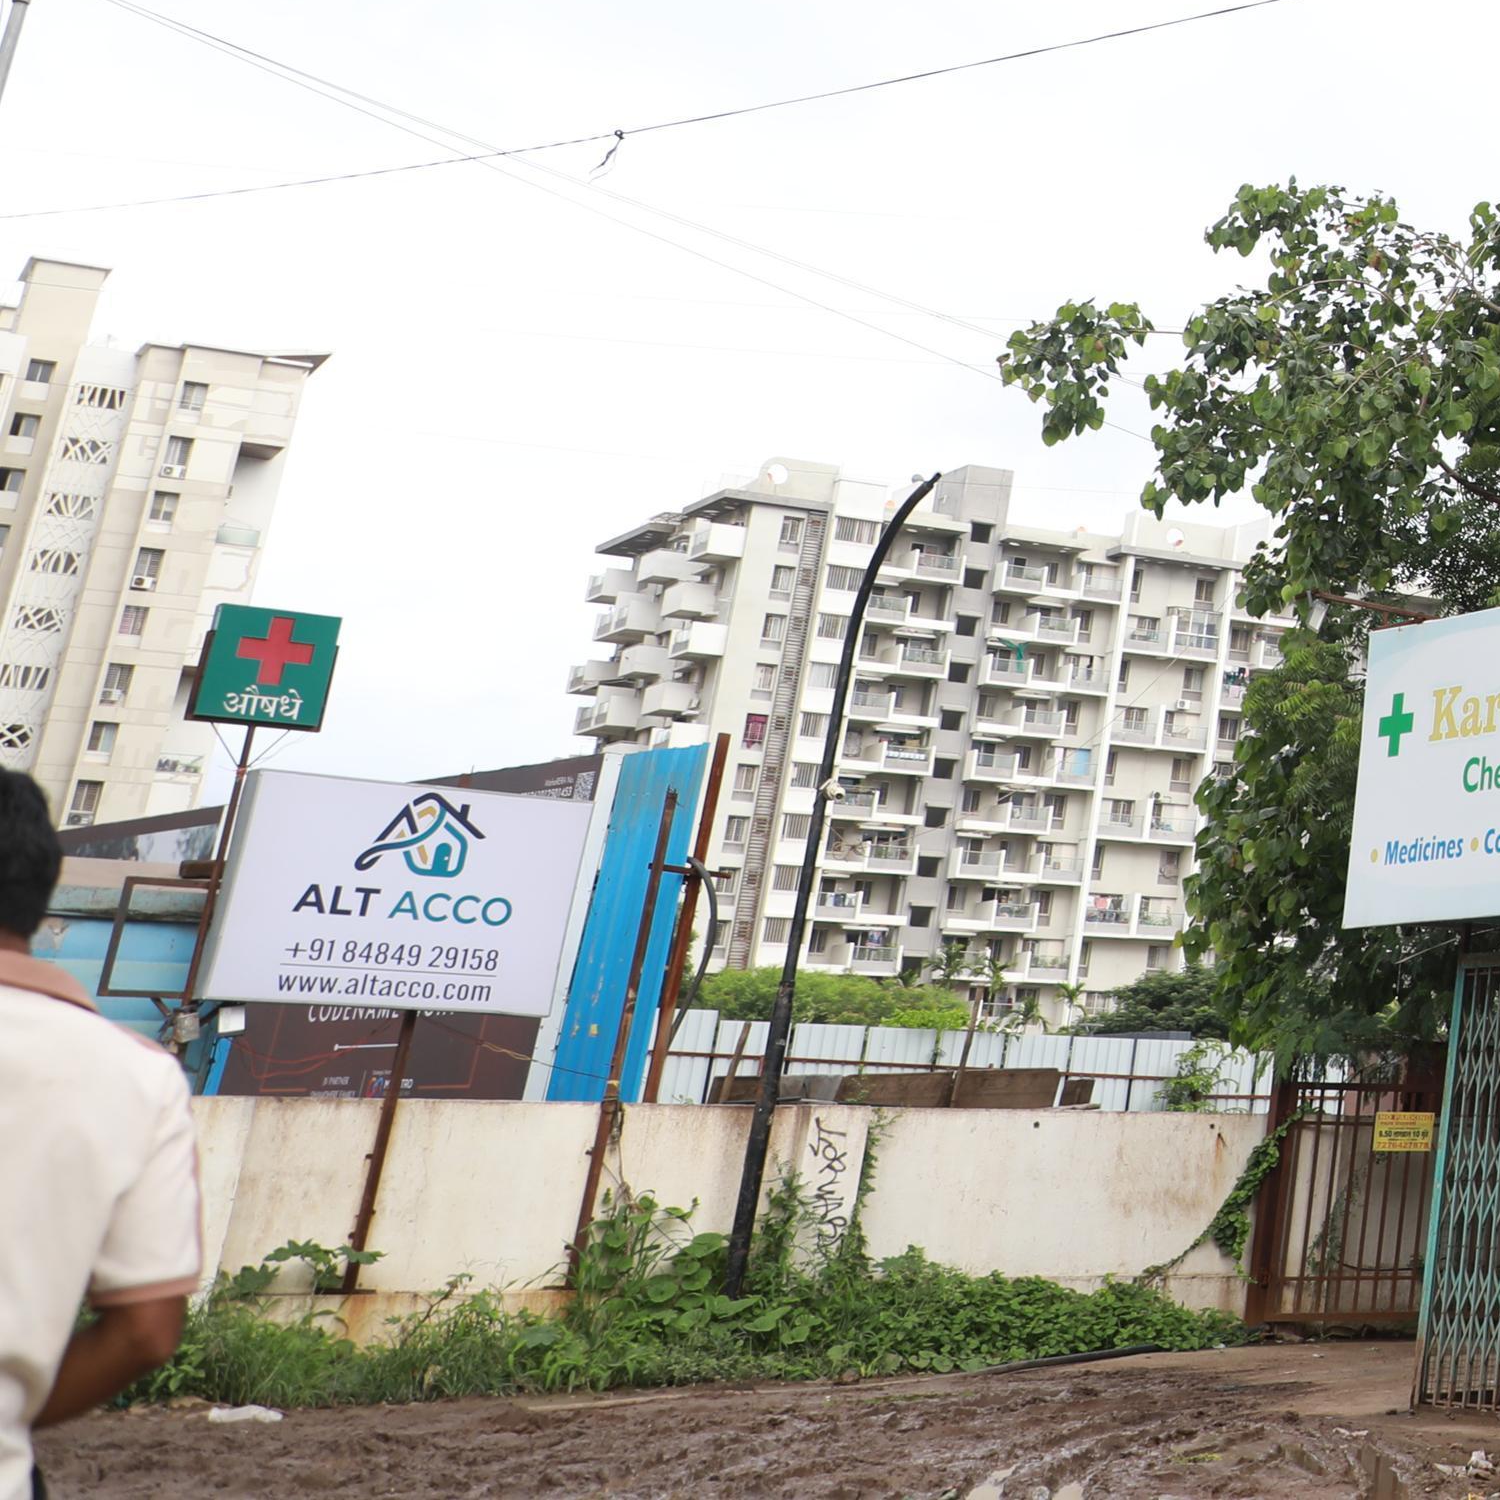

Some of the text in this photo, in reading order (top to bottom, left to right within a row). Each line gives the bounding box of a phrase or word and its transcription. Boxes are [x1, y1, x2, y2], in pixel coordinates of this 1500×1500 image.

[223, 685, 303, 721] औषधे
[1384, 834, 1464, 867] Medicines
[292, 883, 513, 927] ALT ACCO
[284, 938, 499, 972] +91 84849 29158
[278, 972, 492, 1003] www.altacco.com
